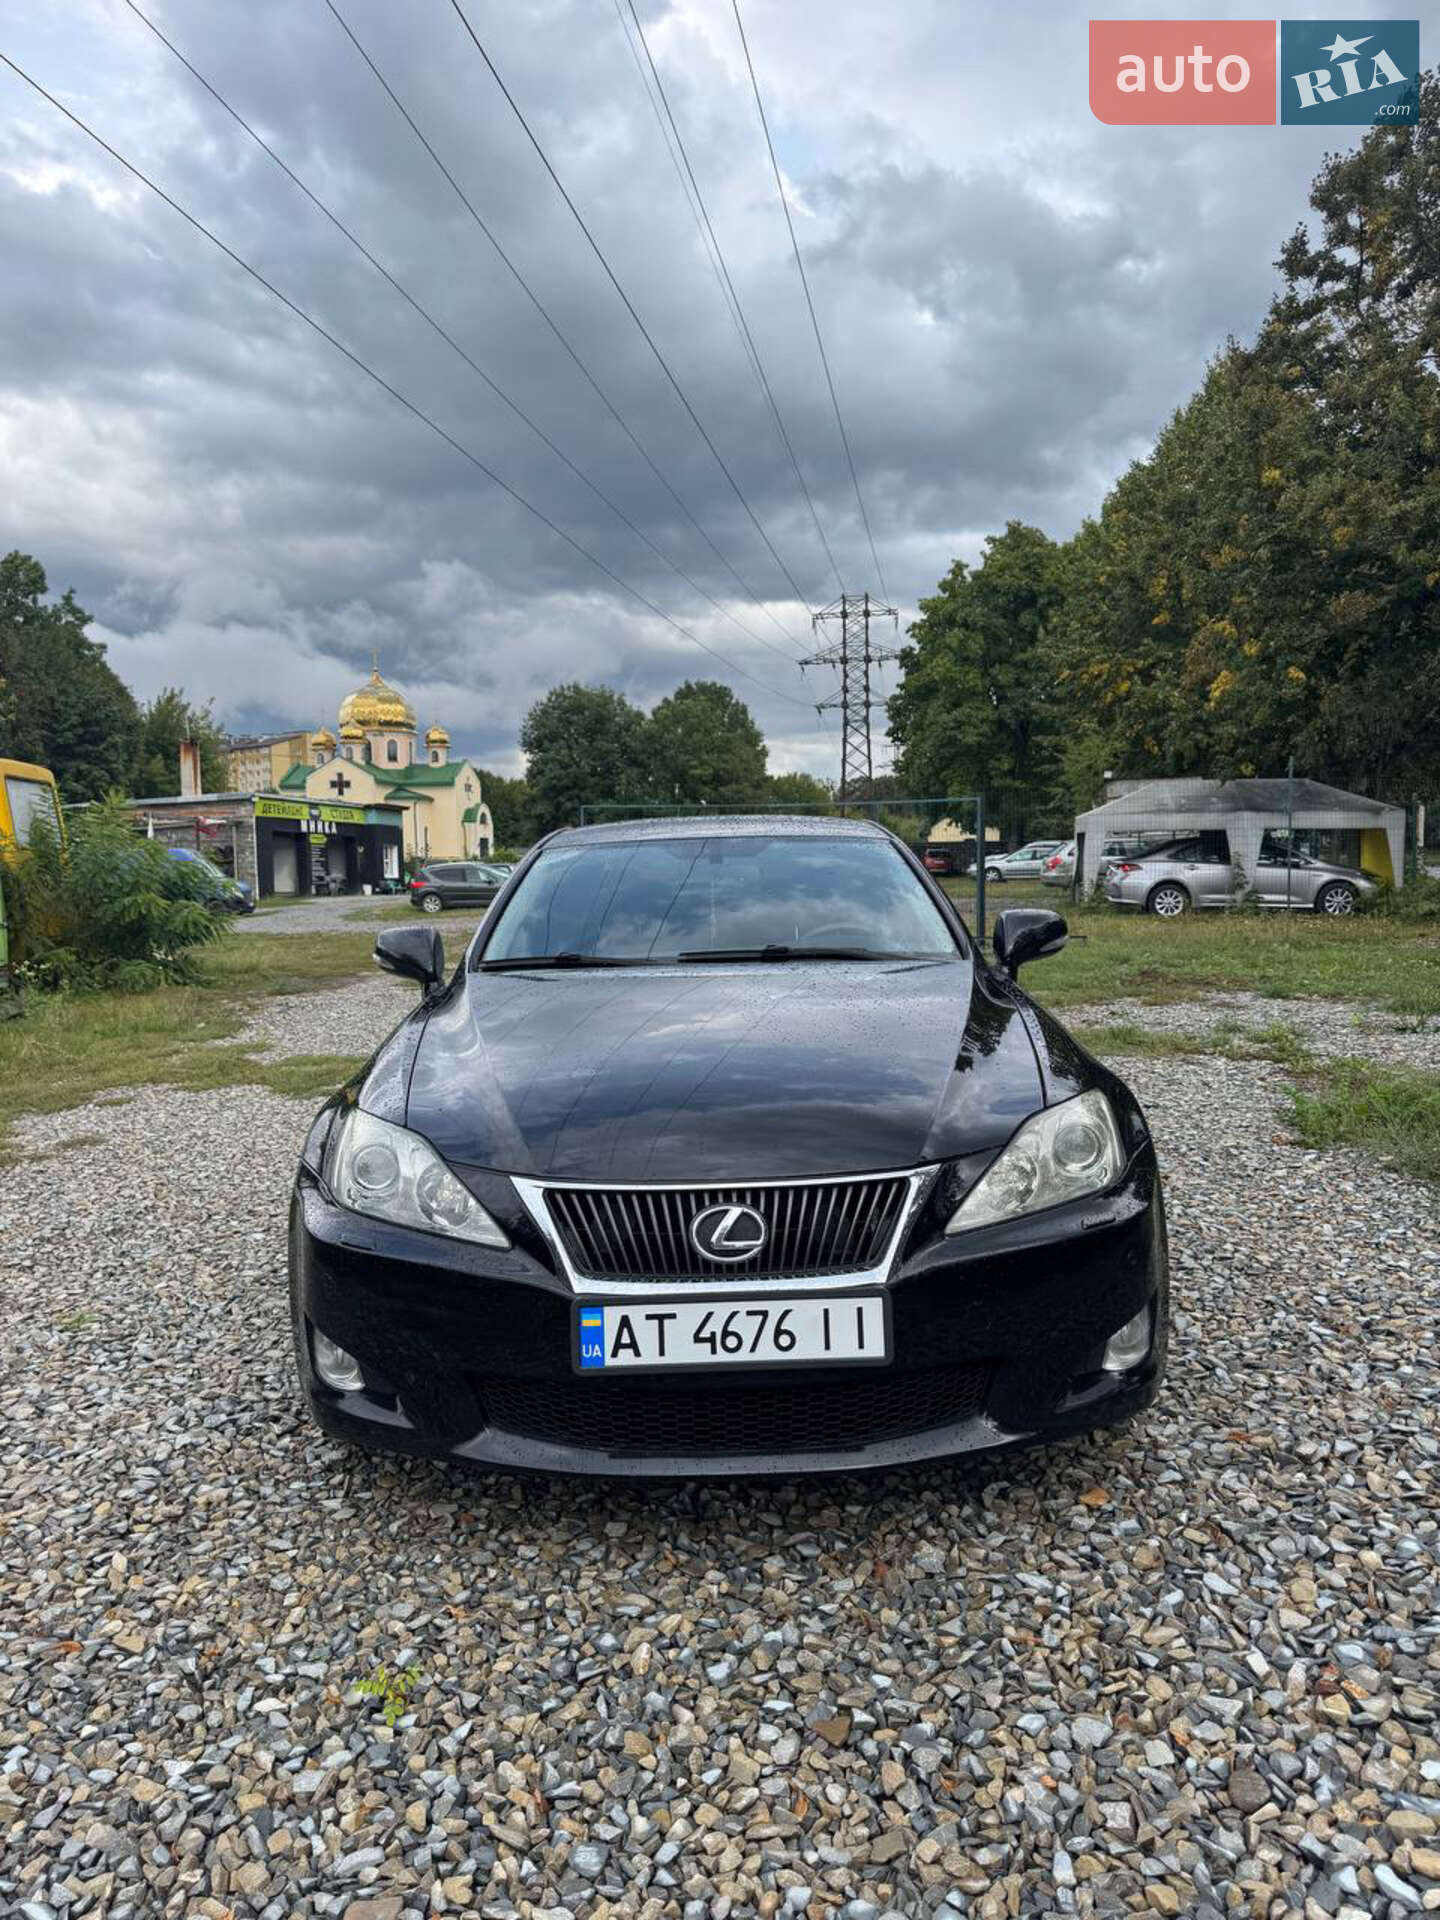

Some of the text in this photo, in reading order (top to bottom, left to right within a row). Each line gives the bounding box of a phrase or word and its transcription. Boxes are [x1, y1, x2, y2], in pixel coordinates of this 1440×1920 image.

[610, 1313, 677, 1358] AT
[693, 1308, 797, 1355] 4676
[582, 1344, 602, 1358] UA
